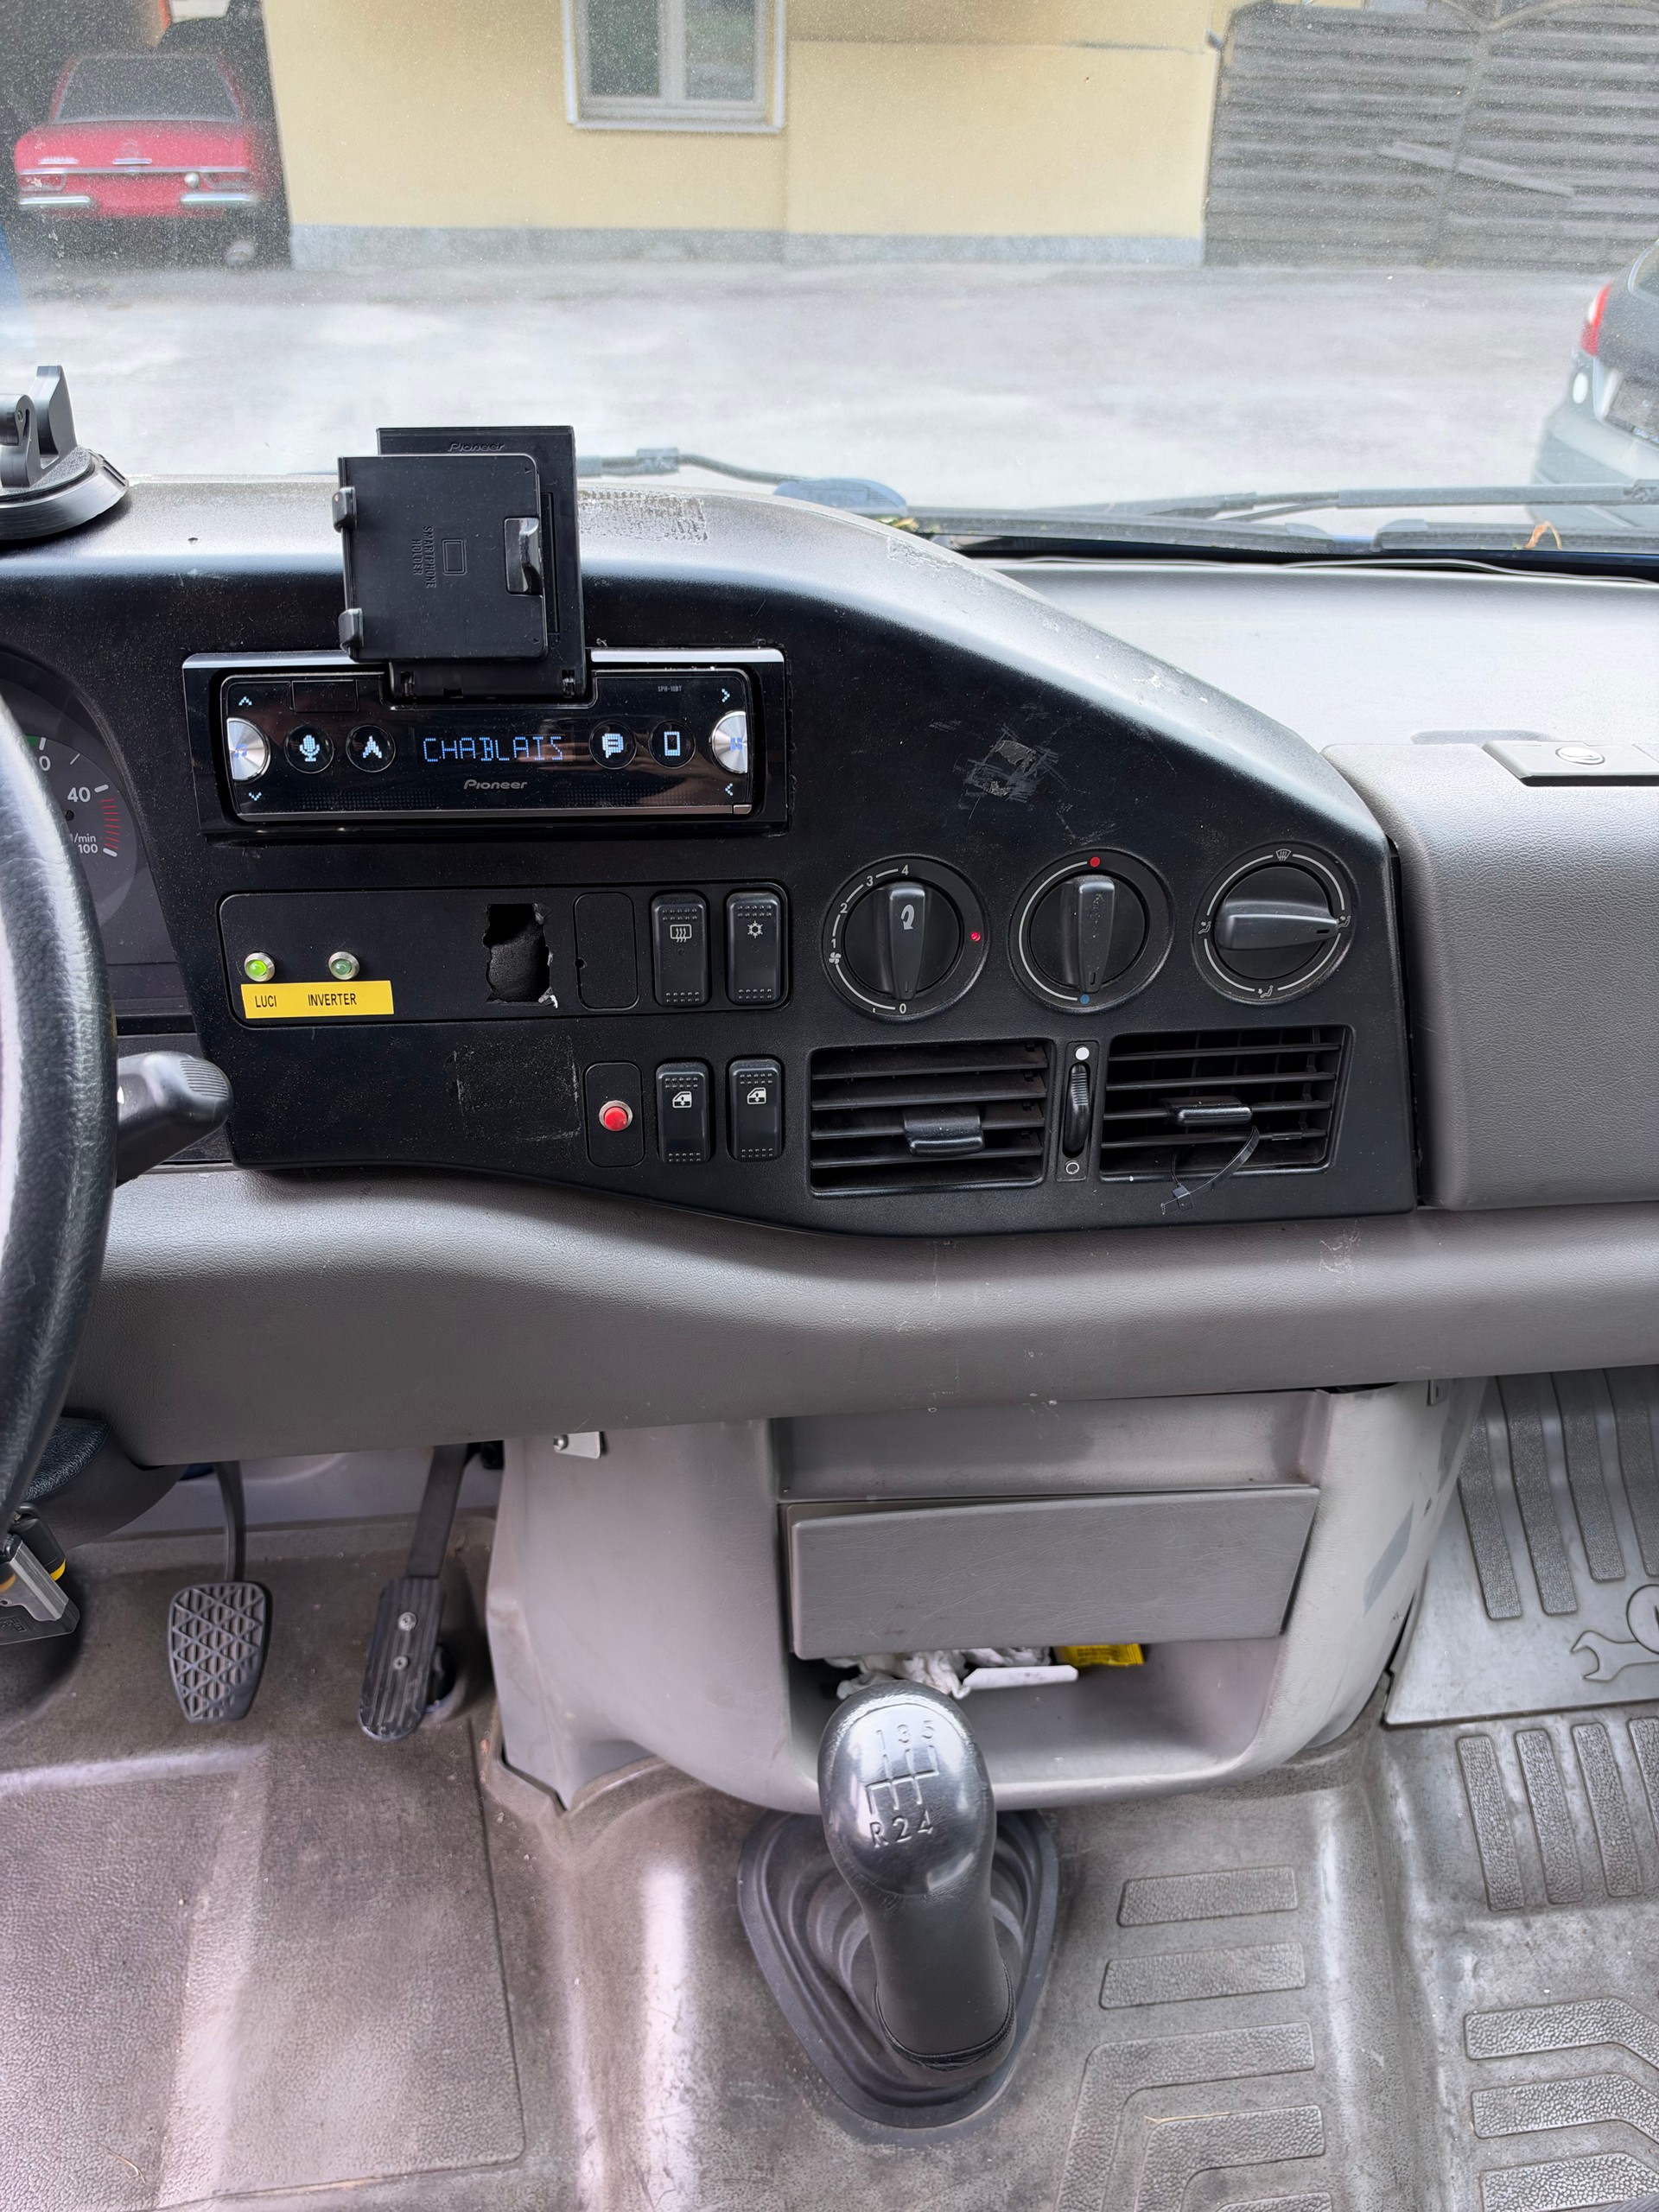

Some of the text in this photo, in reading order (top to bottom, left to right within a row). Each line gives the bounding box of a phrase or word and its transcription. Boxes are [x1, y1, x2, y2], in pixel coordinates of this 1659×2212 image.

[448, 442, 505, 452] Pioneer
[411, 539, 423, 575] HOLDER
[423, 525, 437, 588] SMARTPHONE
[423, 736, 563, 762] CHABLAIS
[39, 755, 51, 772] 0
[463, 779, 528, 790] Pioneer
[67, 786, 91, 803] 40
[78, 843, 99, 854] 100
[901, 864, 909, 876] 4
[866, 875, 874, 887] 3
[840, 902, 848, 914] 2
[831, 938, 836, 949] 1
[255, 993, 357, 1008] LUCI INVERTER
[899, 1002, 906, 1014] 0
[875, 1719, 936, 1751] 1 3 5
[869, 1809, 934, 1848] R 2 4
